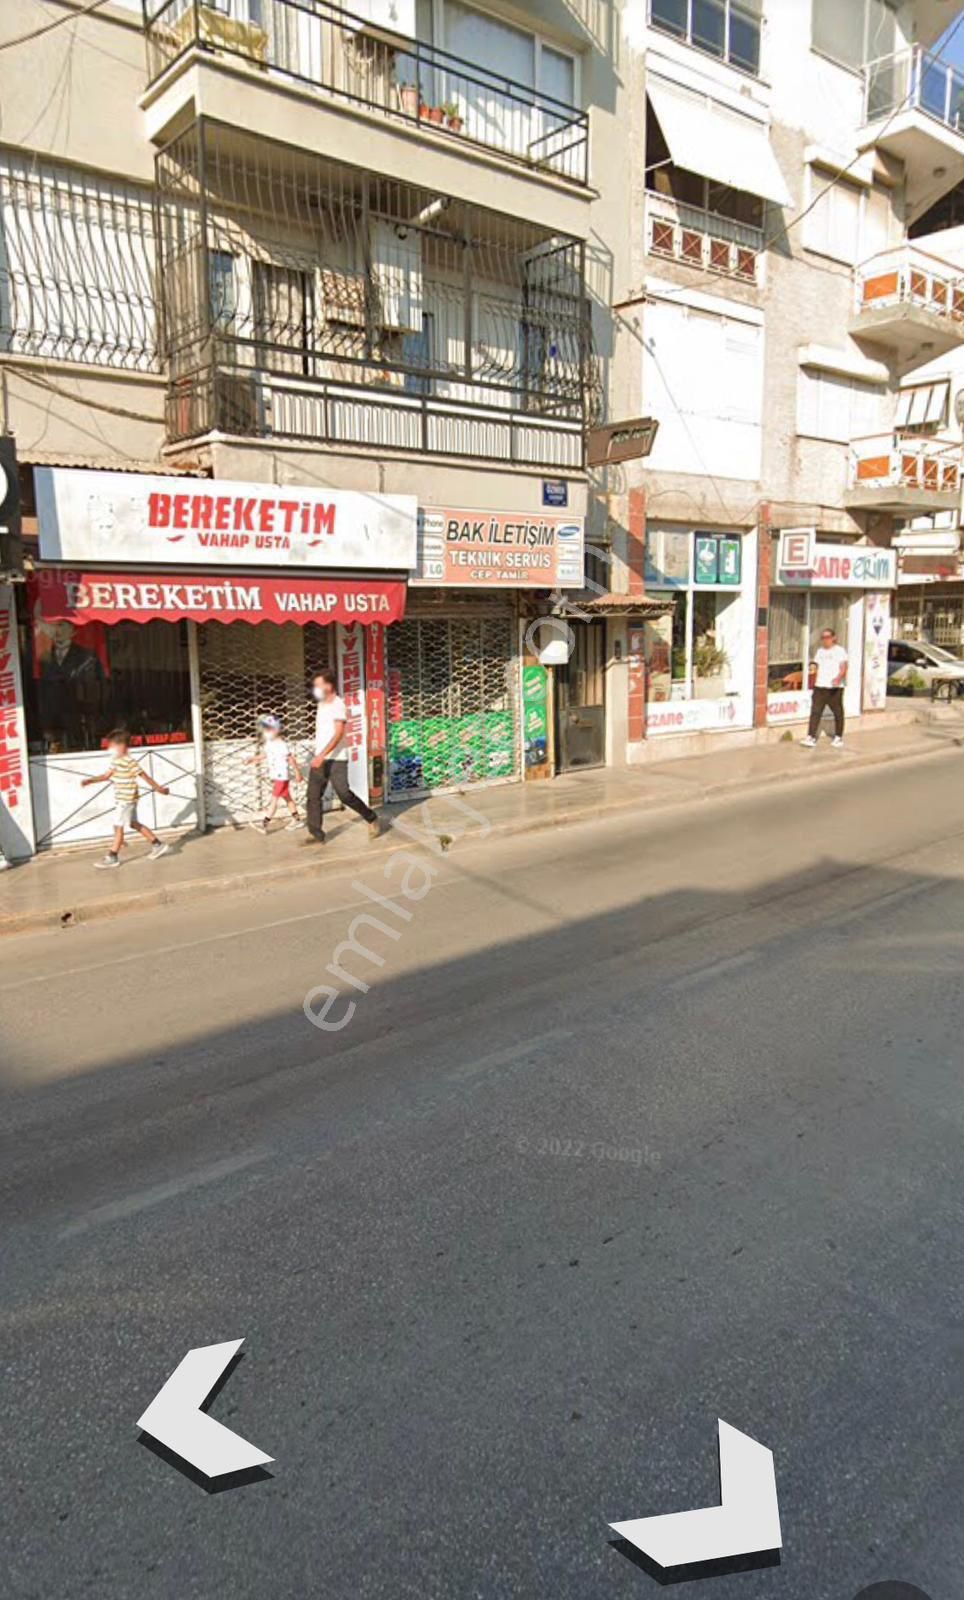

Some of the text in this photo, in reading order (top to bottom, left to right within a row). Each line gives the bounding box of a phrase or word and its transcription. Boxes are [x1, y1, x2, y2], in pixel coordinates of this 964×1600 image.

[198, 533, 290, 550] VAHAP USTA
[446, 517, 555, 550] BAK İLETİŞİM
[449, 549, 502, 567] TEKNİK
[506, 551, 551, 568] SERVİS
[788, 538, 804, 562] E
[470, 570, 492, 580] CEP
[65, 580, 390, 612] BEREKETİM VAHAP USTA
